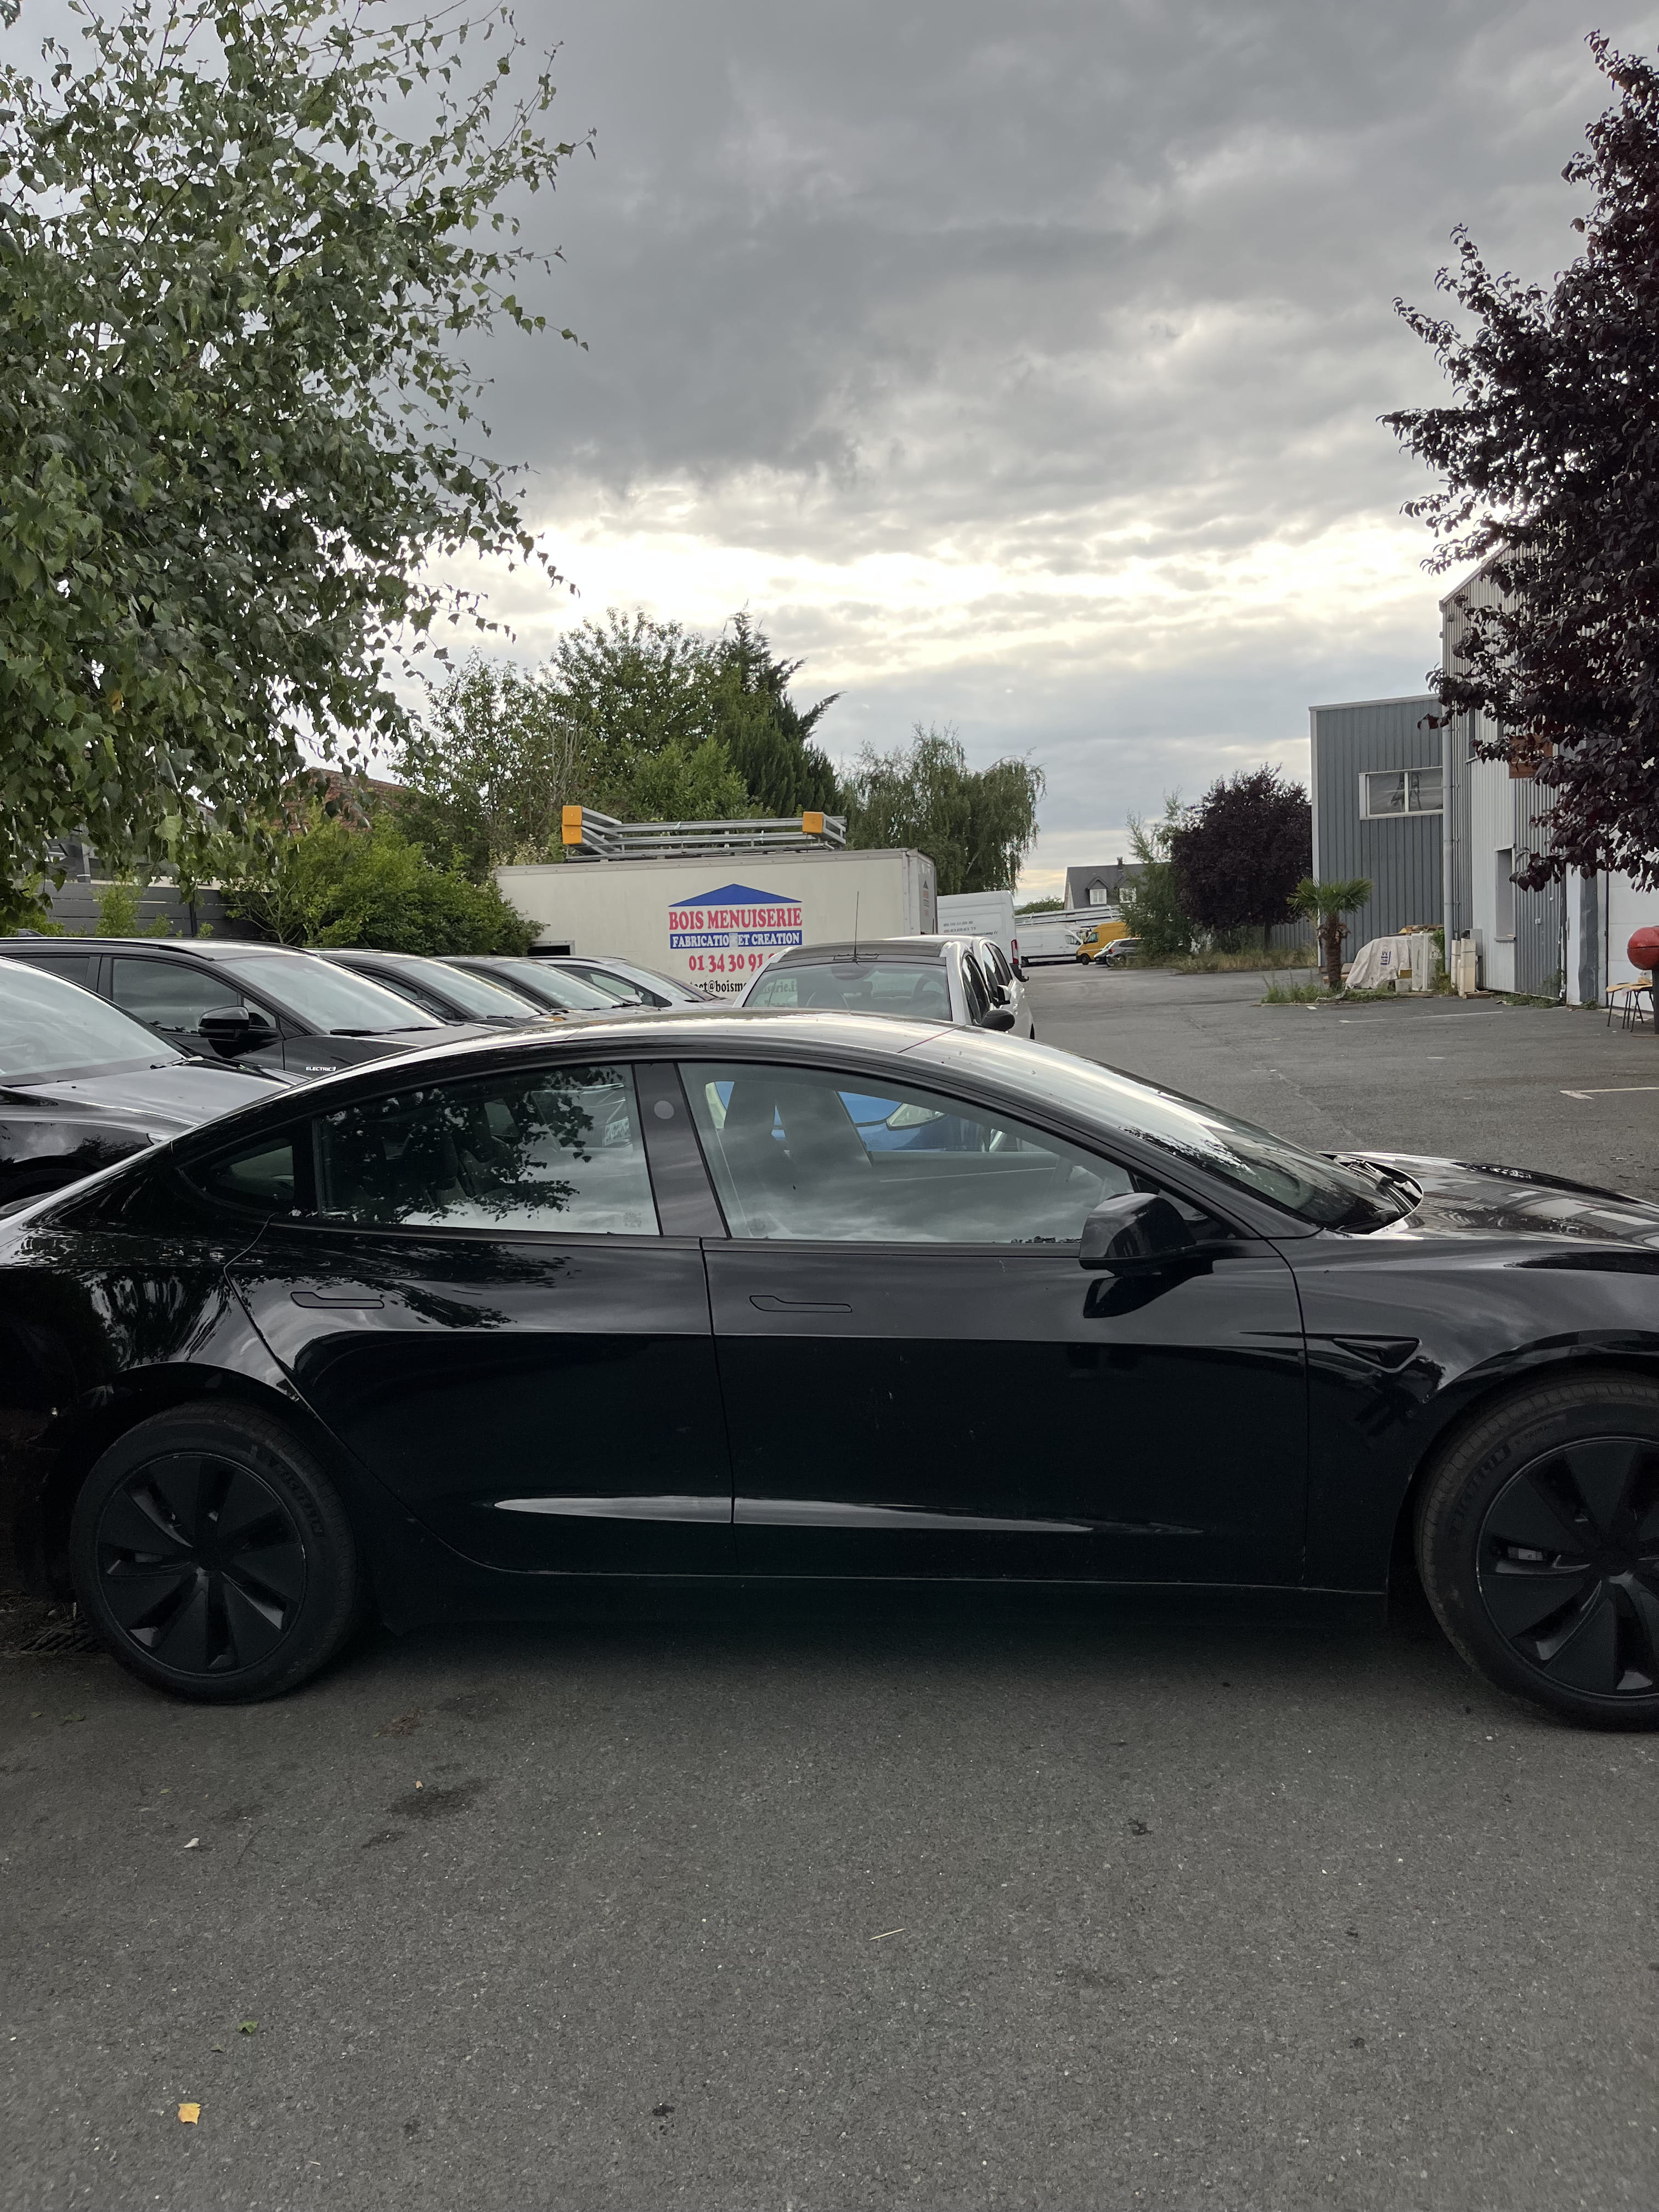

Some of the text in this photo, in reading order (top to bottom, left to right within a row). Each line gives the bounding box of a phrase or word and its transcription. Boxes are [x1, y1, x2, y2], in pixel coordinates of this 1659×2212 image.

[669, 907, 802, 930] BOIS MENUISERIE
[672, 933, 800, 947] FABRICATIO ET CREATION
[689, 953, 763, 972] 01 34 30 91
